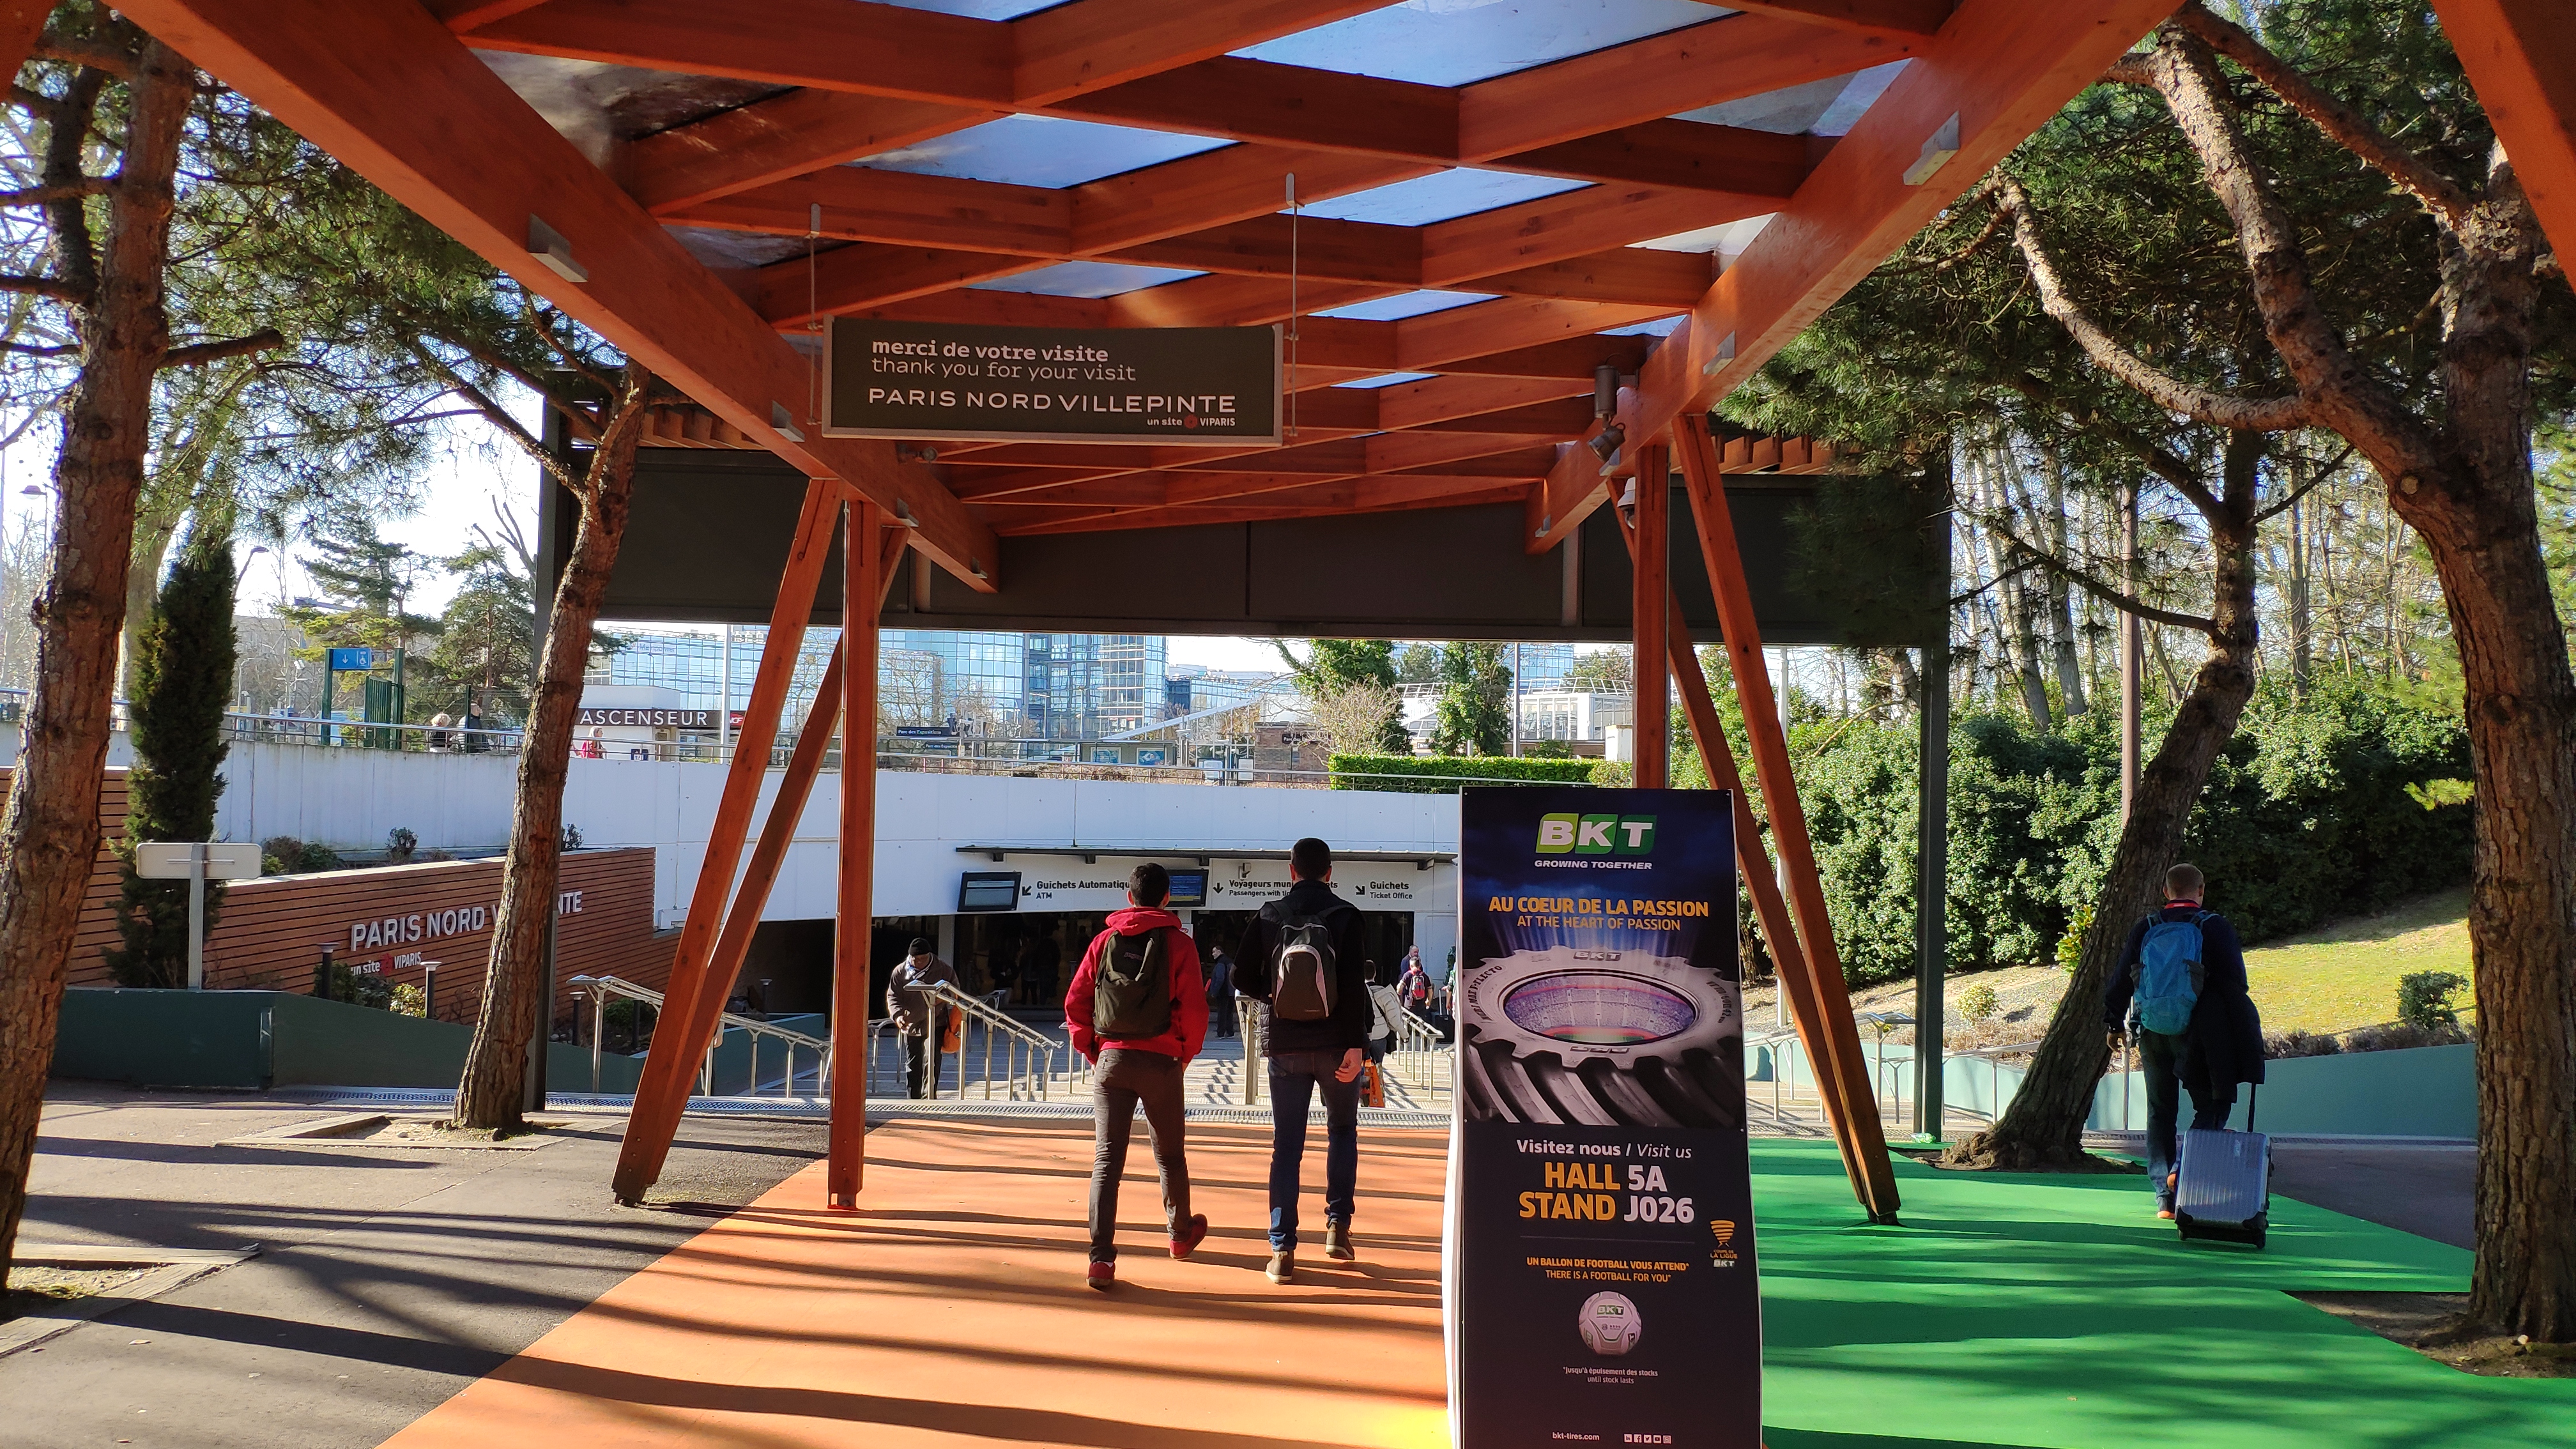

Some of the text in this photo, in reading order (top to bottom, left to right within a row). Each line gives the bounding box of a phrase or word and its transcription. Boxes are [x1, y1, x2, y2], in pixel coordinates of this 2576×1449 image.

[872, 340, 1108, 362] merci de votre visite
[871, 358, 1137, 382] thank you for your visit
[868, 388, 1236, 413] PARIS NORD VILLEPINTE
[1162, 417, 1183, 426] site
[1199, 417, 1236, 426] VIPARIS
[579, 710, 707, 726] ASCENSEUR
[1539, 820, 1653, 848] BKT
[1534, 860, 1653, 870] GROWING TOGETHER
[1036, 880, 1130, 891] Guichets Automatiqu
[1229, 880, 1271, 889] Voyageurs
[1370, 881, 1409, 889] Guichets
[1489, 896, 1514, 912] AU
[1578, 898, 1602, 914] DE
[1606, 899, 1629, 916] LA
[1632, 900, 1709, 917] PASSION
[351, 914, 422, 951] PARIS
[426, 906, 485, 939] NORD
[1517, 916, 1681, 931] AT THE HEART OF PASSION
[363, 960, 381, 974] site
[394, 951, 422, 969] VIPARIS
[1574, 951, 1621, 960] BKT
[1516, 1139, 1692, 1159] Visitez nous / Visit us
[1544, 1162, 1667, 1192] HALL 5A
[1519, 1191, 1695, 1223] STAND J026
[1526, 1257, 1539, 1266] UN
[1540, 1258, 1573, 1268] BALLON
[1574, 1259, 1586, 1268] DE
[1586, 1259, 1629, 1269] FOOTBALL
[1630, 1261, 1653, 1270] VOUS
[1545, 1269, 1572, 1279] THERE
[1573, 1270, 1581, 1279] IS
[1582, 1271, 1589, 1280] A
[1590, 1271, 1632, 1282] FOOTBALL
[1633, 1273, 1650, 1282] FOR
[1597, 1305, 1624, 1315] BKT
[1552, 1431, 1600, 1441] bkt-tires.com
